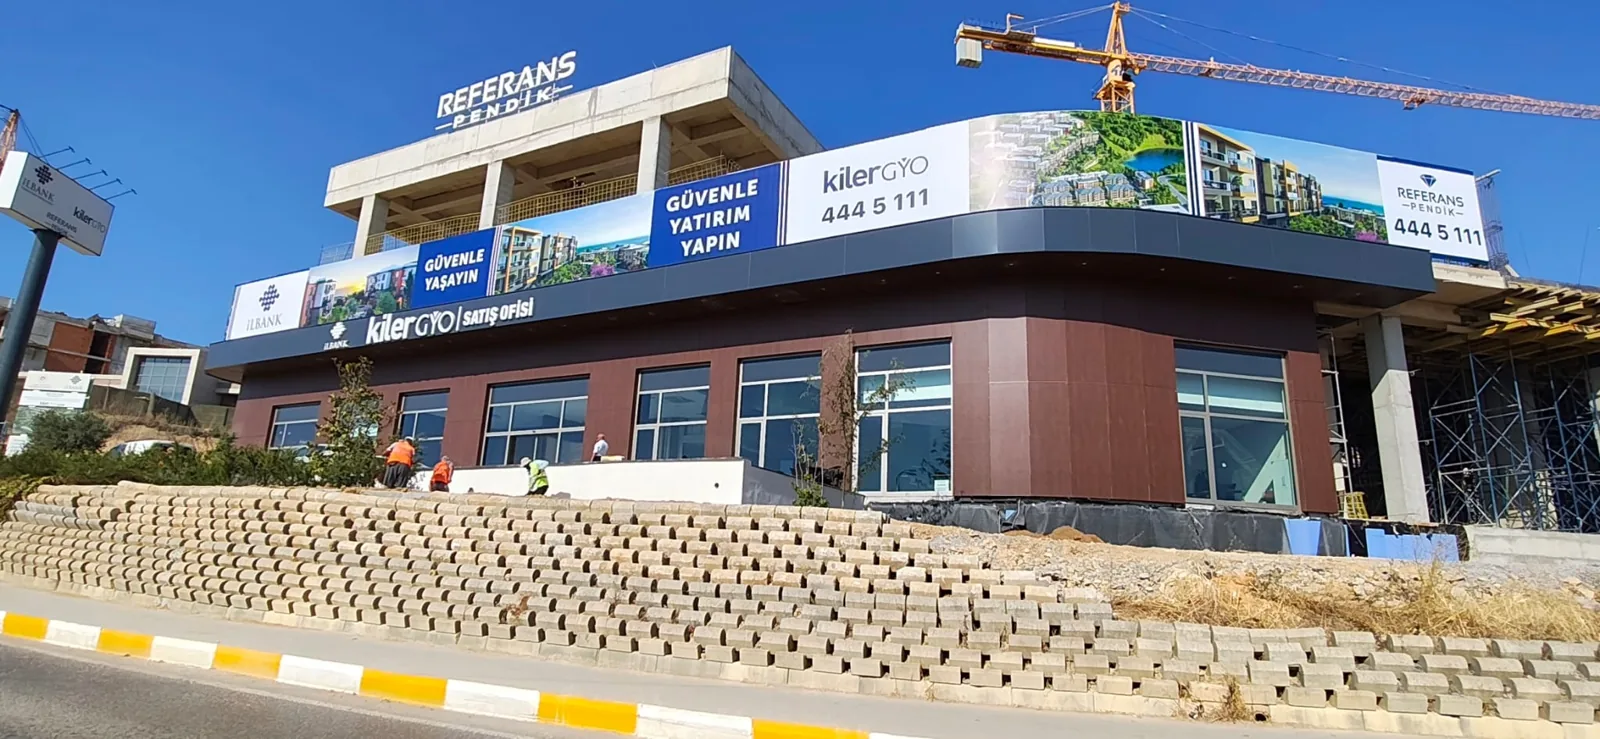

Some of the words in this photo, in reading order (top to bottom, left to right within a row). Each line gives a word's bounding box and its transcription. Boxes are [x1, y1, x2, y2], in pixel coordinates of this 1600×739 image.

[437, 51, 576, 118] REFERANS
[823, 156, 929, 193] kilerGYO
[666, 179, 758, 212] GÜVENLE
[822, 201, 866, 224] 444
[873, 197, 886, 214] 5
[893, 188, 929, 211] 111
[1397, 187, 1464, 207] REFERANS
[1411, 202, 1455, 216] PENDİK
[669, 205, 750, 235] YATIRIM
[1394, 218, 1432, 238] 444
[1437, 224, 1449, 240] 5
[1453, 227, 1482, 246] 111
[680, 231, 740, 257] YAPIN
[425, 249, 485, 272] GÜVENLE
[425, 269, 479, 292] YAŞAYIN
[462, 306, 499, 326] SATIŞ
[500, 297, 534, 320] OFİSİ
